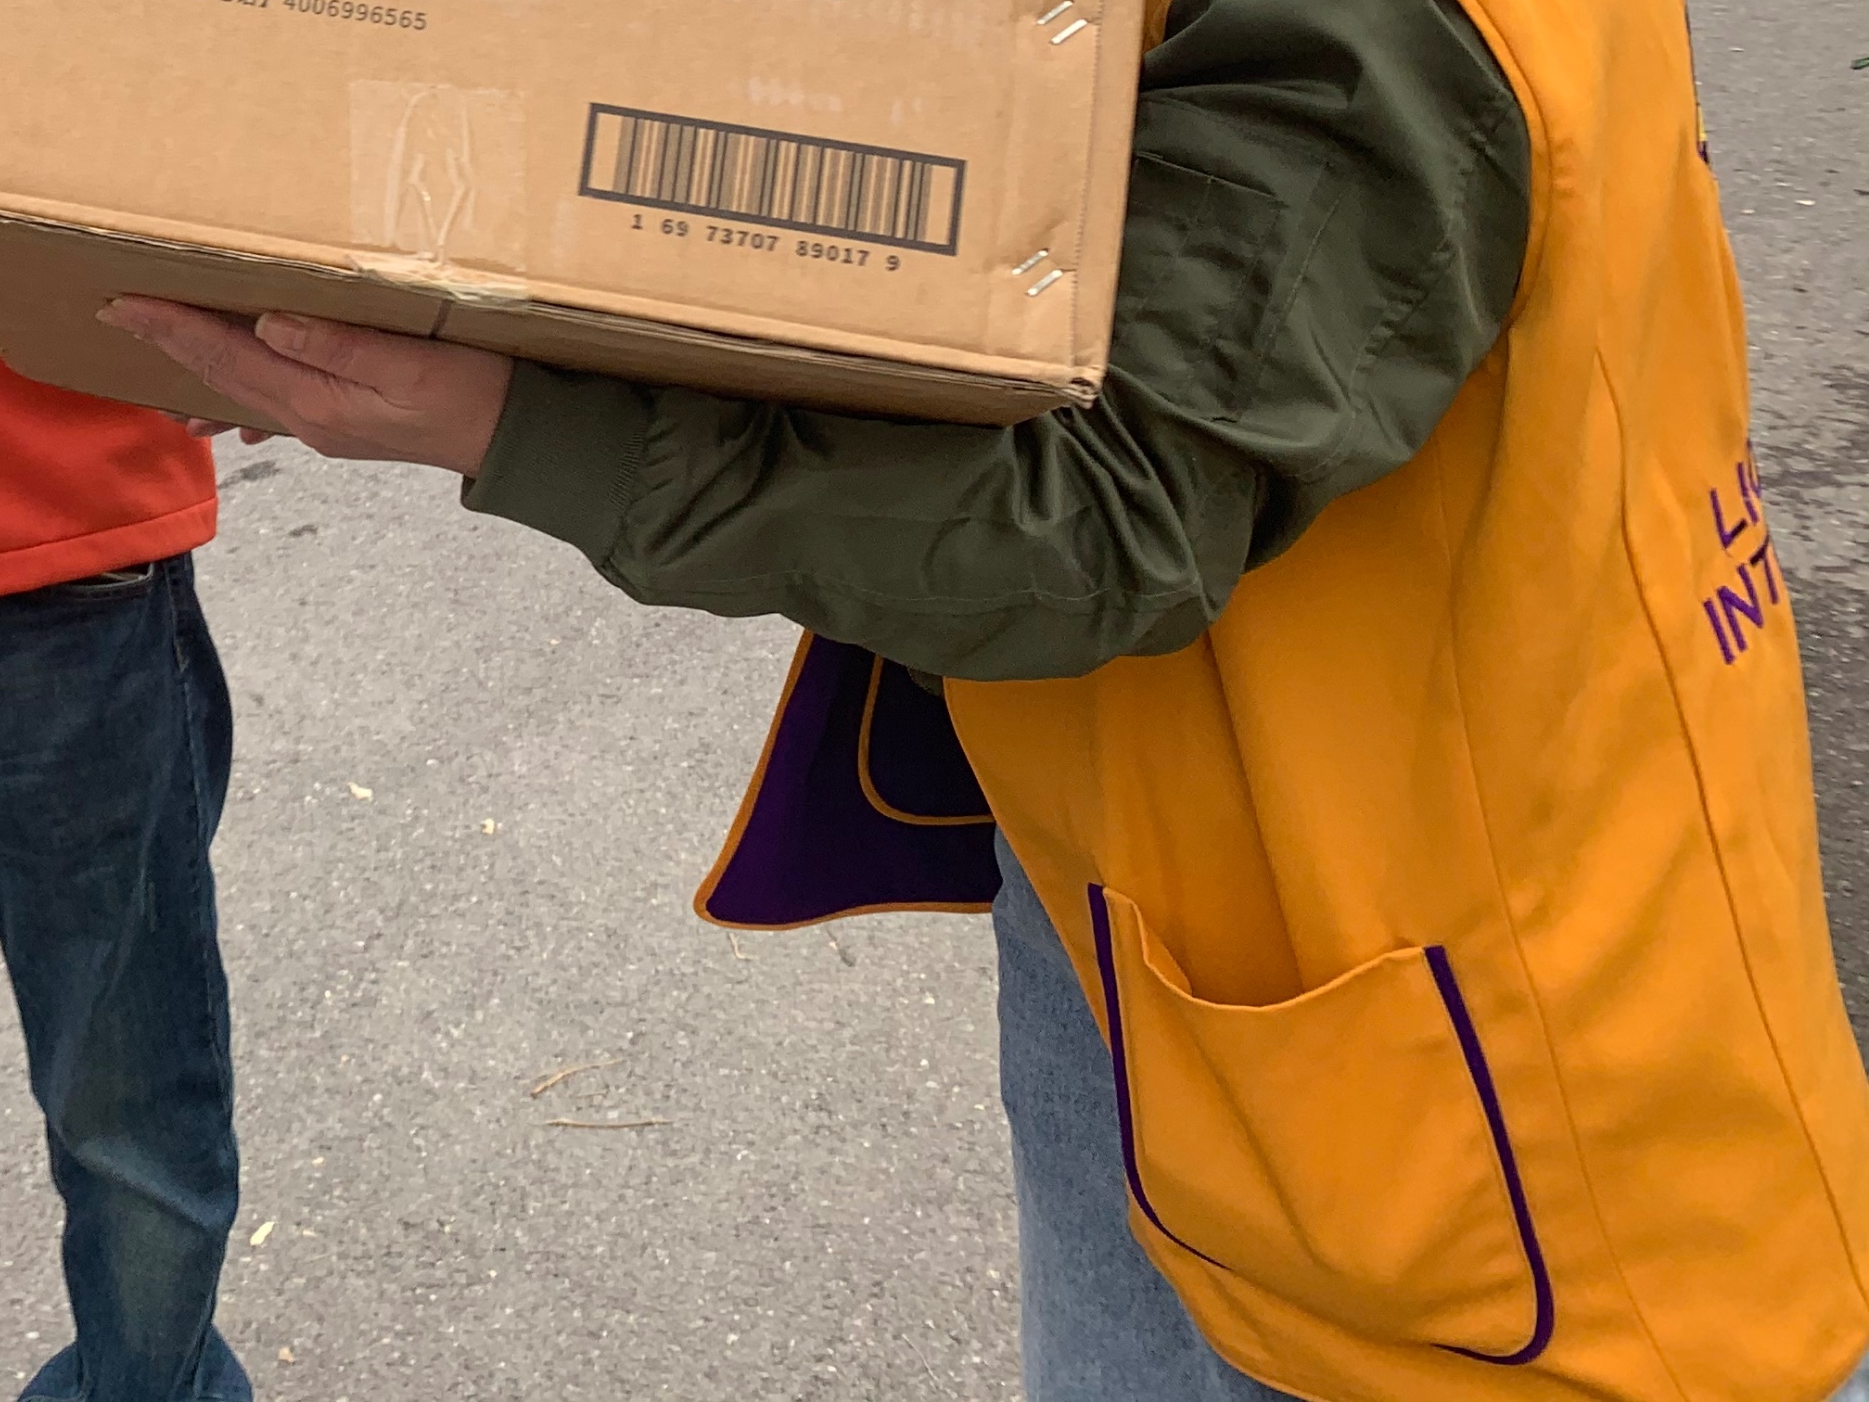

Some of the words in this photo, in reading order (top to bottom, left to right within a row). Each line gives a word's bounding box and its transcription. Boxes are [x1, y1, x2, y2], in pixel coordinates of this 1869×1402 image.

[631, 214, 643, 230] 1
[661, 219, 689, 237] 69
[707, 226, 780, 252] 73707
[796, 241, 870, 267] 89017
[886, 256, 901, 271] 9
